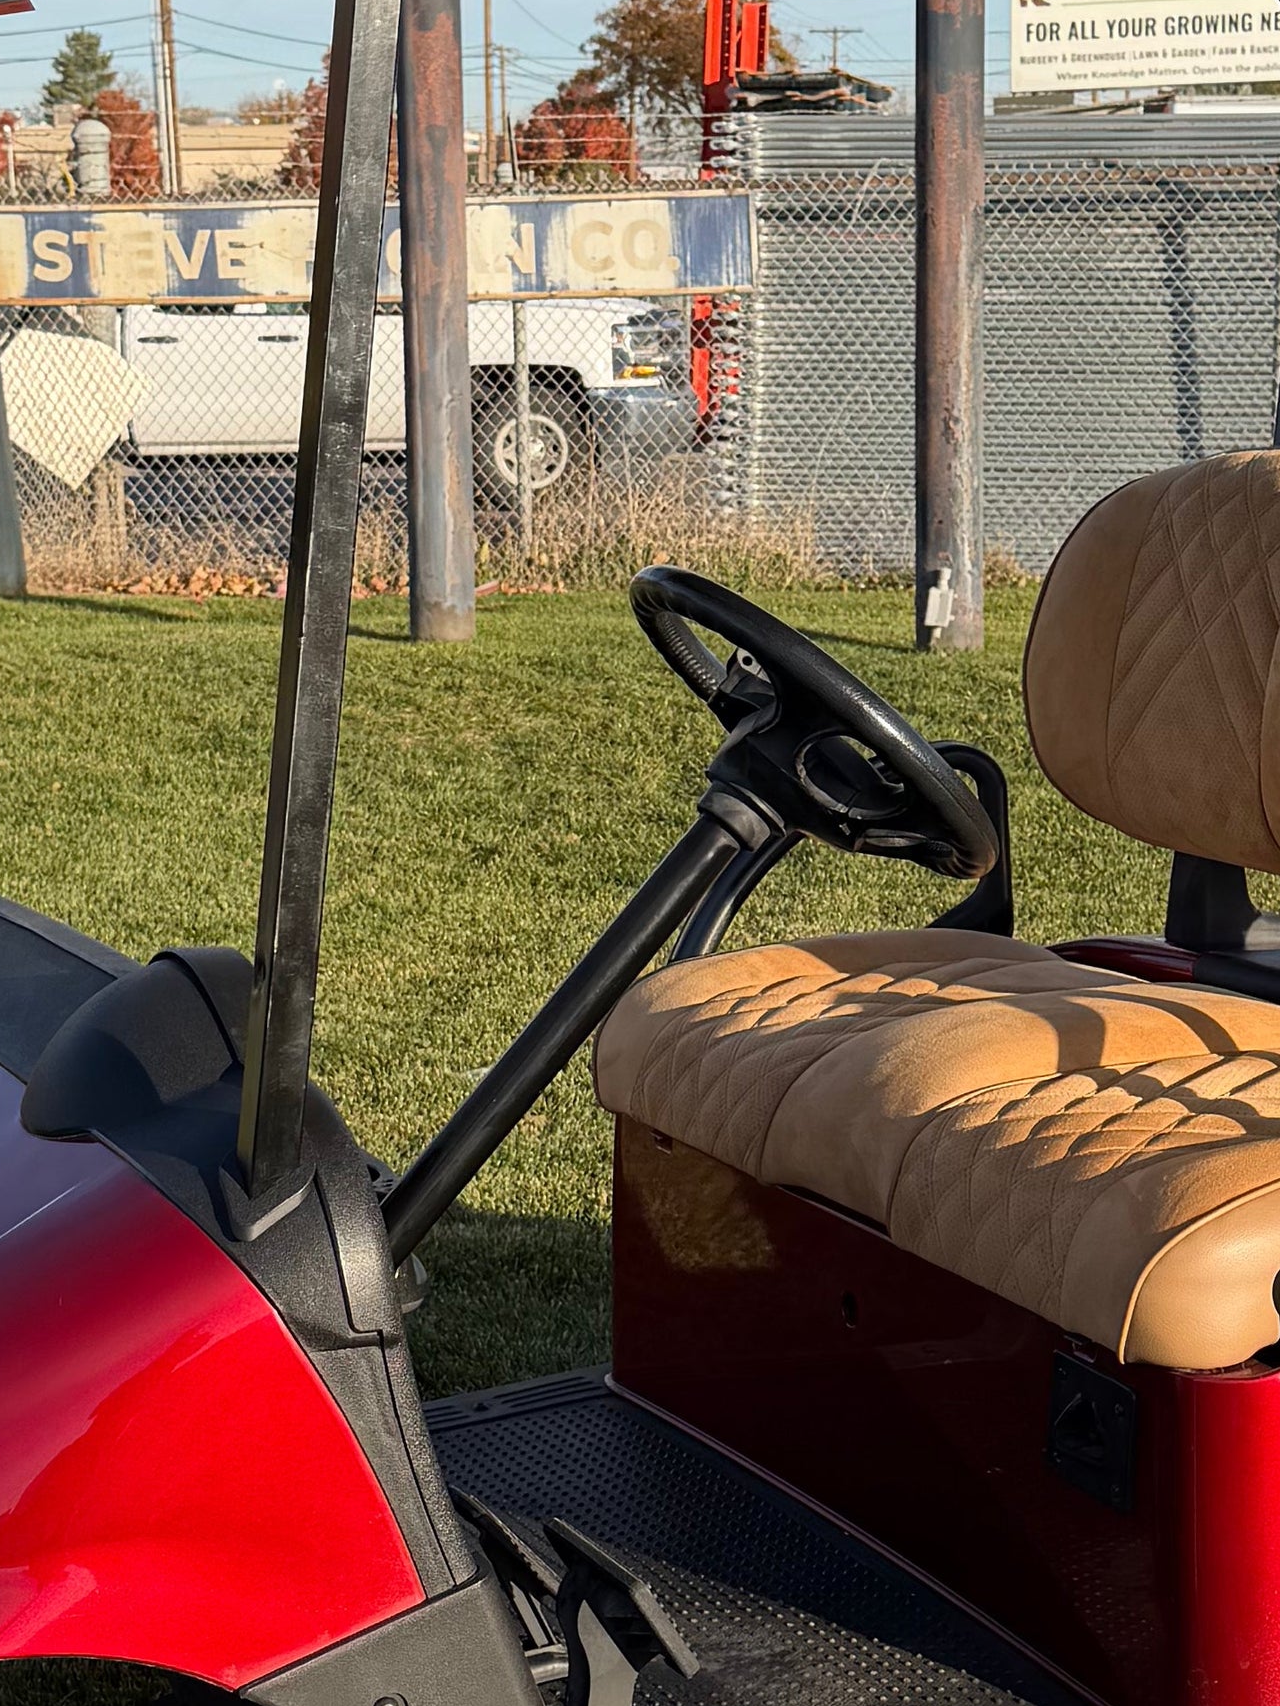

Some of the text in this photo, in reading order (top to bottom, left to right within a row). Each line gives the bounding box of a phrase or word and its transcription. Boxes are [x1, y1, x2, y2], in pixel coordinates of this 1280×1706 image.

[1026, 22, 1061, 42] FOR
[1068, 20, 1100, 40] ALL
[1106, 17, 1157, 39] YOUR
[1164, 13, 1253, 36] GROWING
[1057, 71, 1088, 80] Where
[1091, 68, 1145, 80] Knowledge
[1148, 67, 1188, 77] Matters.
[1192, 66, 1219, 77] Open
[1222, 66, 1233, 75] to
[1235, 64, 1251, 74] the
